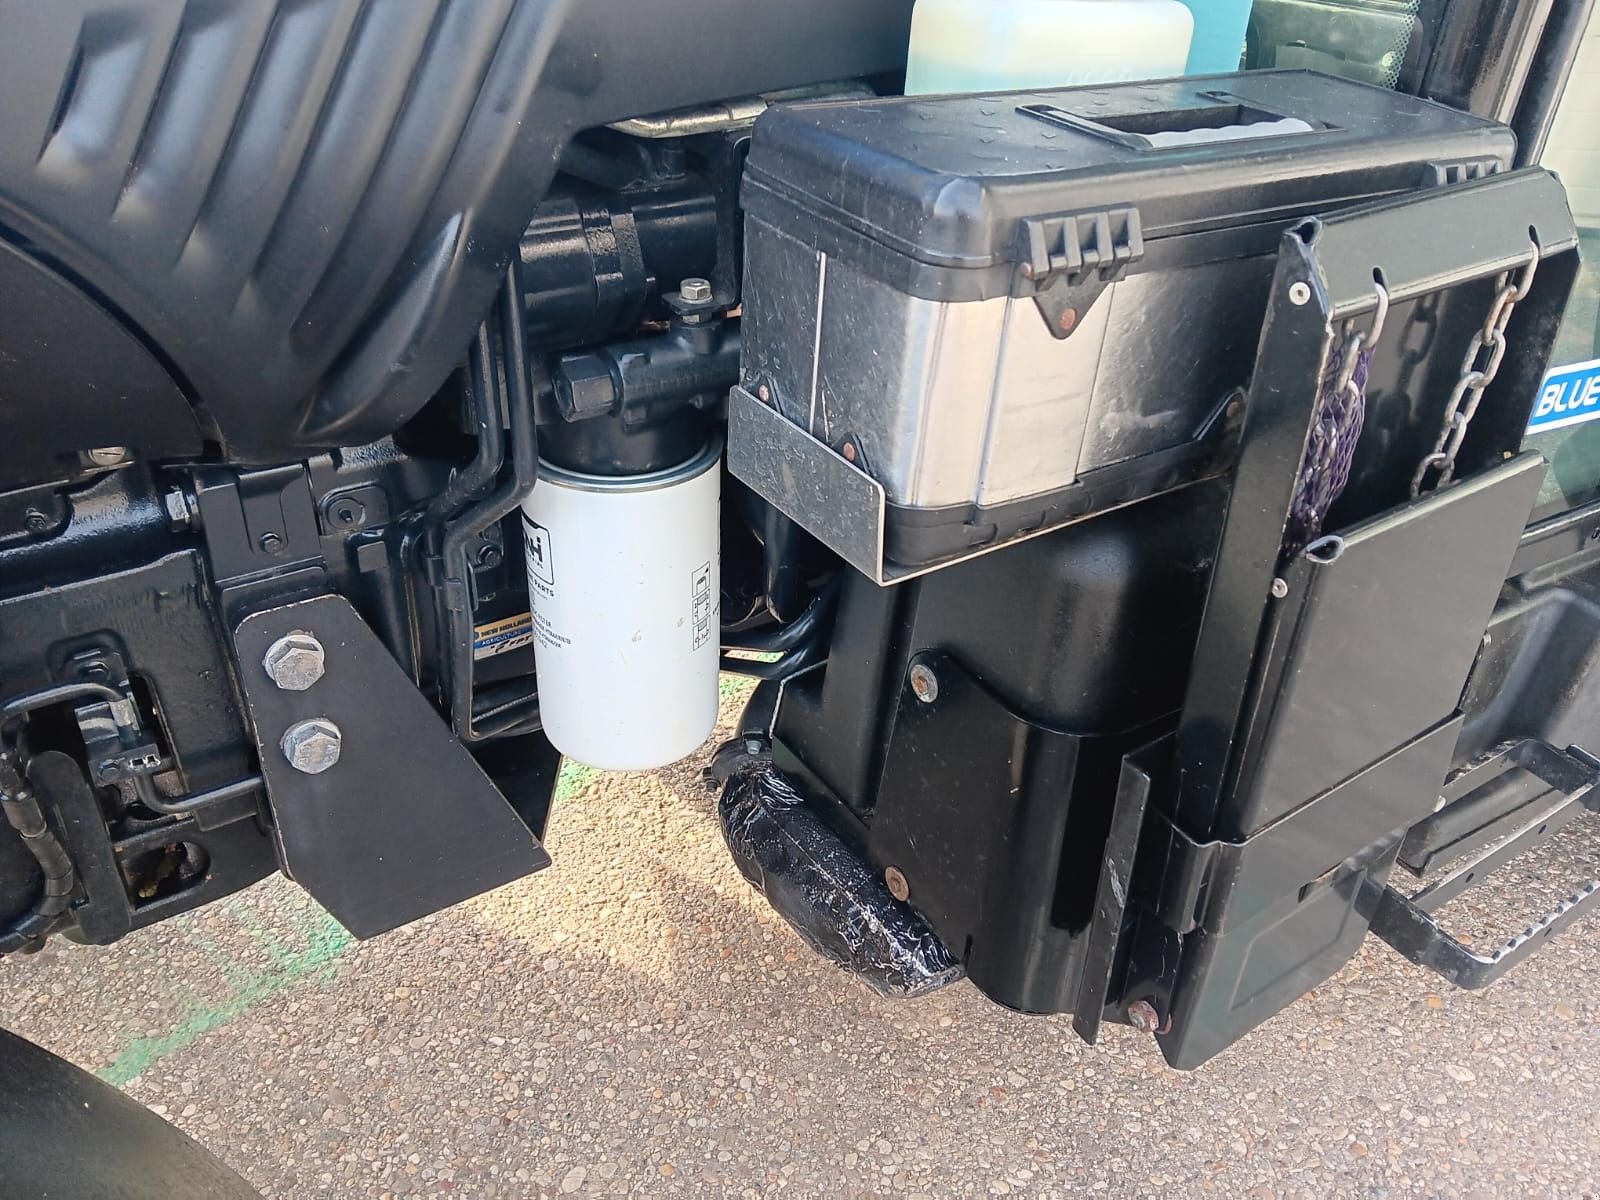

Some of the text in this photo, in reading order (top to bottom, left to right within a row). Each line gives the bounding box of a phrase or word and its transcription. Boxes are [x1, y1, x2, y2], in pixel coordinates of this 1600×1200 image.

[1535, 375, 1600, 418] BLUE
[481, 627, 499, 638] NEW
[500, 616, 532, 632] HOLLAND
[482, 629, 523, 646] AGRICULTURE
